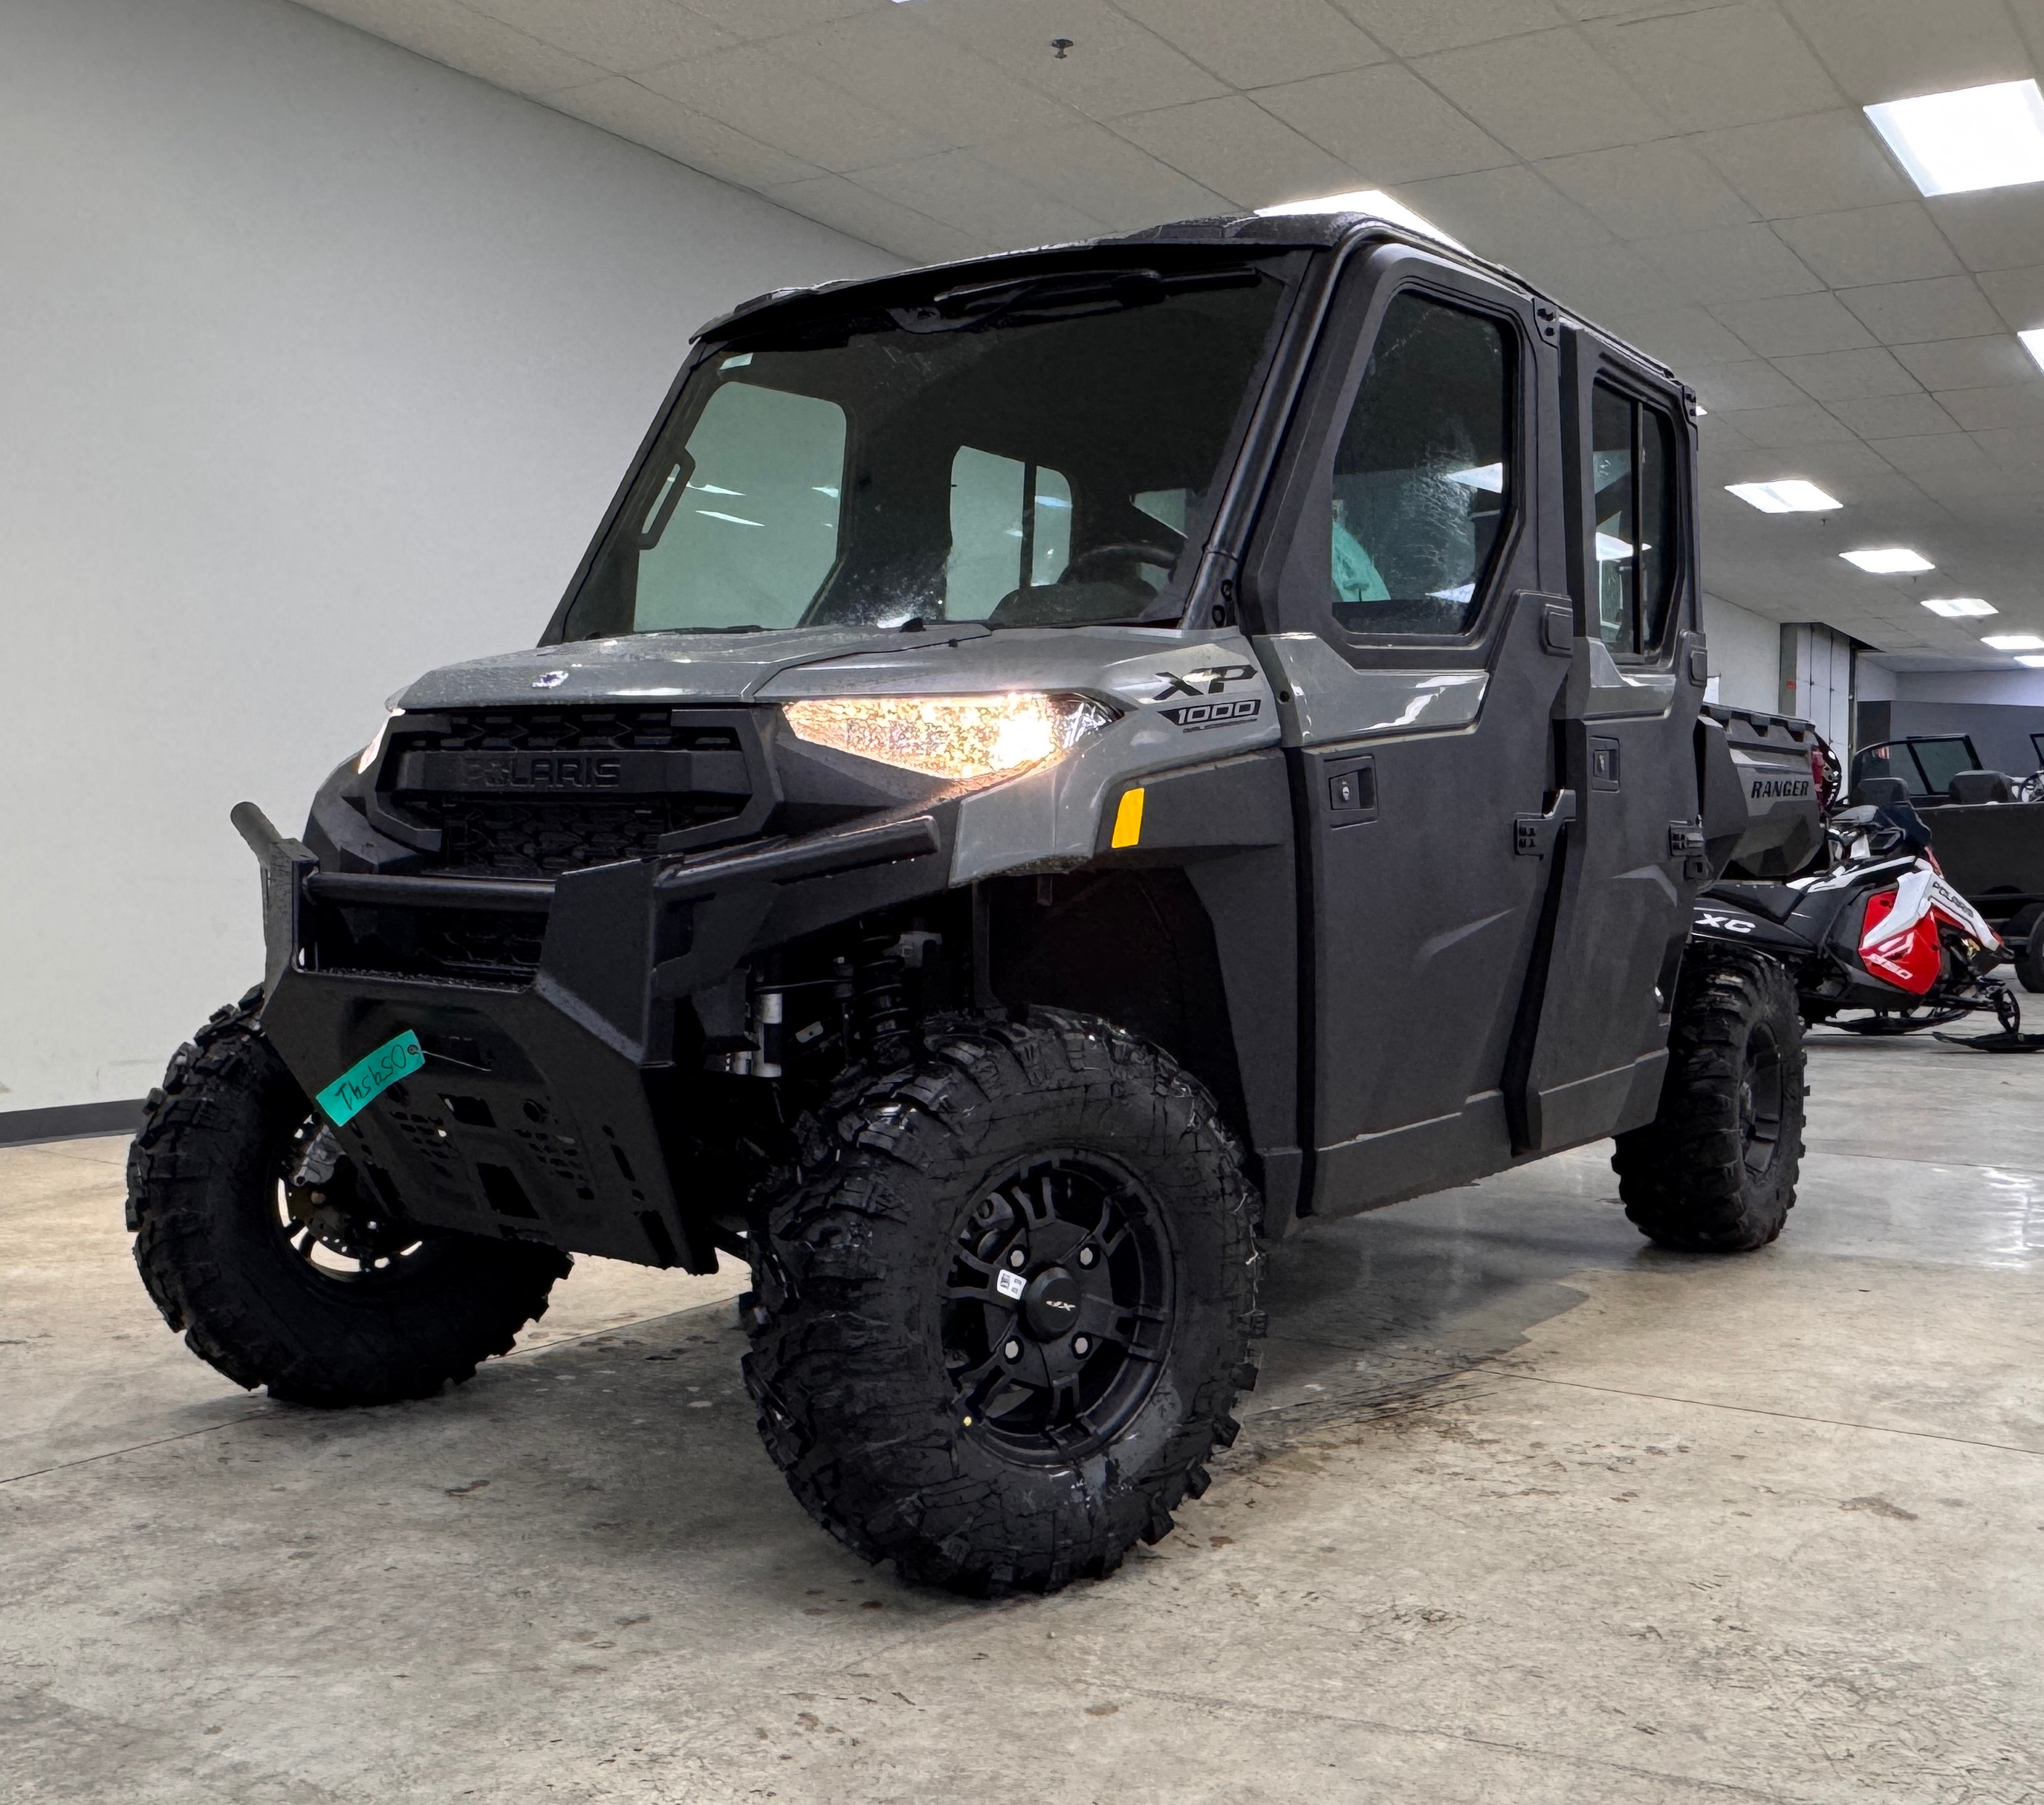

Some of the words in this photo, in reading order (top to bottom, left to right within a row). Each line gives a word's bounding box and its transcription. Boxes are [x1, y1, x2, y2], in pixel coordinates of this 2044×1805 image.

[1153, 664, 1258, 700] XP
[1178, 701, 1255, 725] 1000
[1751, 780, 1809, 798] RANGER
[1695, 913, 1756, 933] XC
